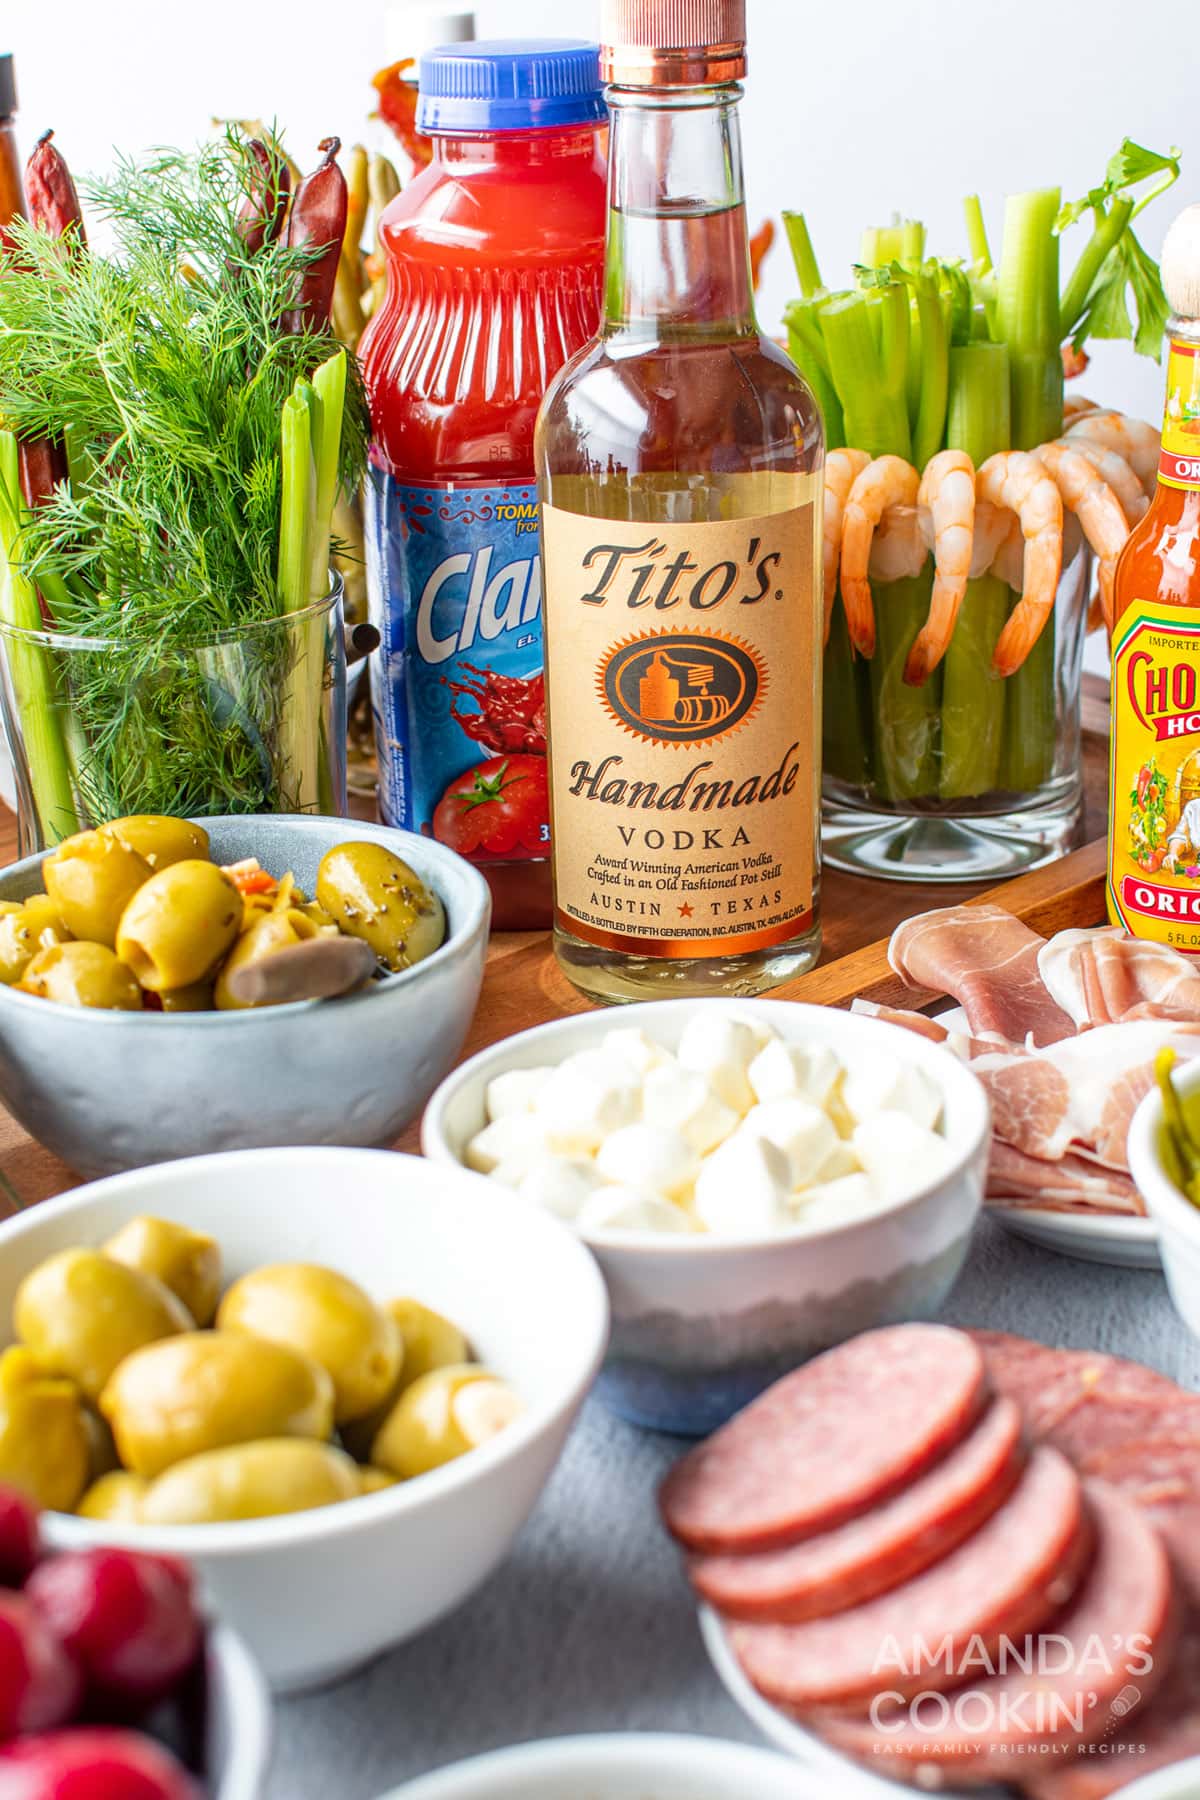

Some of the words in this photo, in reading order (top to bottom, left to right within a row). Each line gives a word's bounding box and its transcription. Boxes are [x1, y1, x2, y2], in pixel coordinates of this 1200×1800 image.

[517, 634, 538, 649] EL
[568, 741, 800, 813] Handmade
[617, 825, 752, 850] VODKA
[587, 866, 622, 886] Crafted
[624, 874, 635, 887] in
[638, 878, 653, 889] an
[655, 878, 678, 890] Old
[681, 875, 738, 890] Fashioned
[740, 874, 759, 886] Pot
[760, 864, 782, 881] Still
[594, 853, 628, 870] Award
[631, 860, 682, 877] Winning
[684, 862, 740, 875] American
[742, 852, 774, 870] Vodka
[589, 892, 662, 916] AUSTIN
[710, 890, 782, 916] TEXAS
[590, 916, 596, 924] &
[595, 917, 625, 932] BOTTLED
[626, 924, 637, 933] BY
[637, 926, 659, 936] FIFTH
[660, 927, 711, 937] GENERATION,
[712, 926, 728, 936] INC.
[728, 922, 757, 934] AUSTIN,
[1168, 932, 1173, 942] 5
